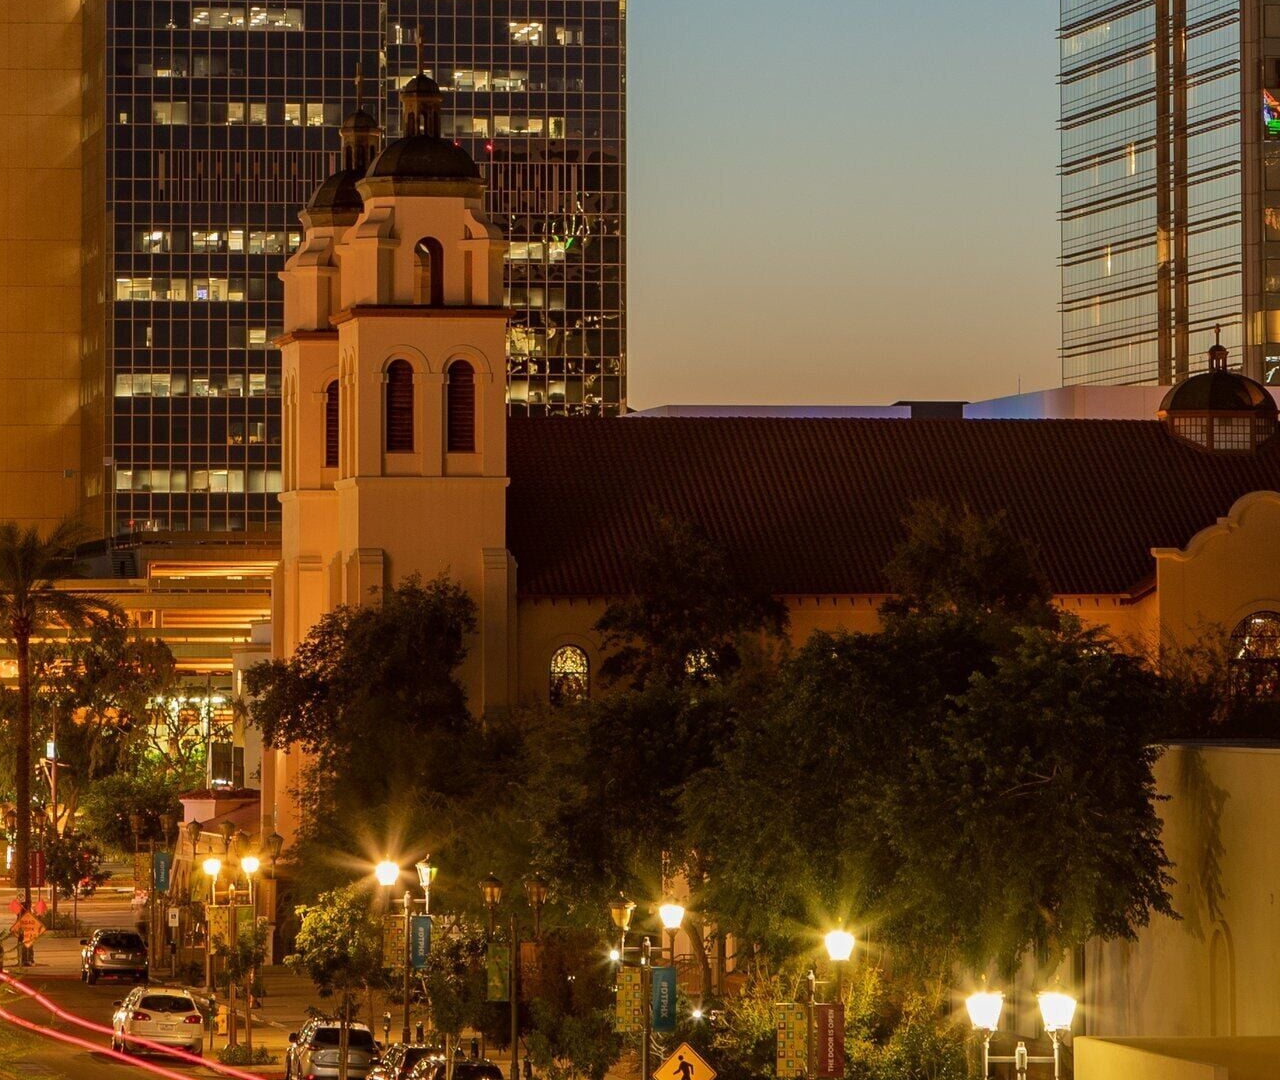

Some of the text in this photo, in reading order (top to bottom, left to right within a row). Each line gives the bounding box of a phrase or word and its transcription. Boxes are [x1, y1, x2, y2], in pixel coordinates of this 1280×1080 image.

[660, 981, 669, 1018] #DTPHX
[827, 1009, 835, 1028] OPEN
[827, 1037, 835, 1058] DOOR
[827, 1059, 835, 1072] THE
